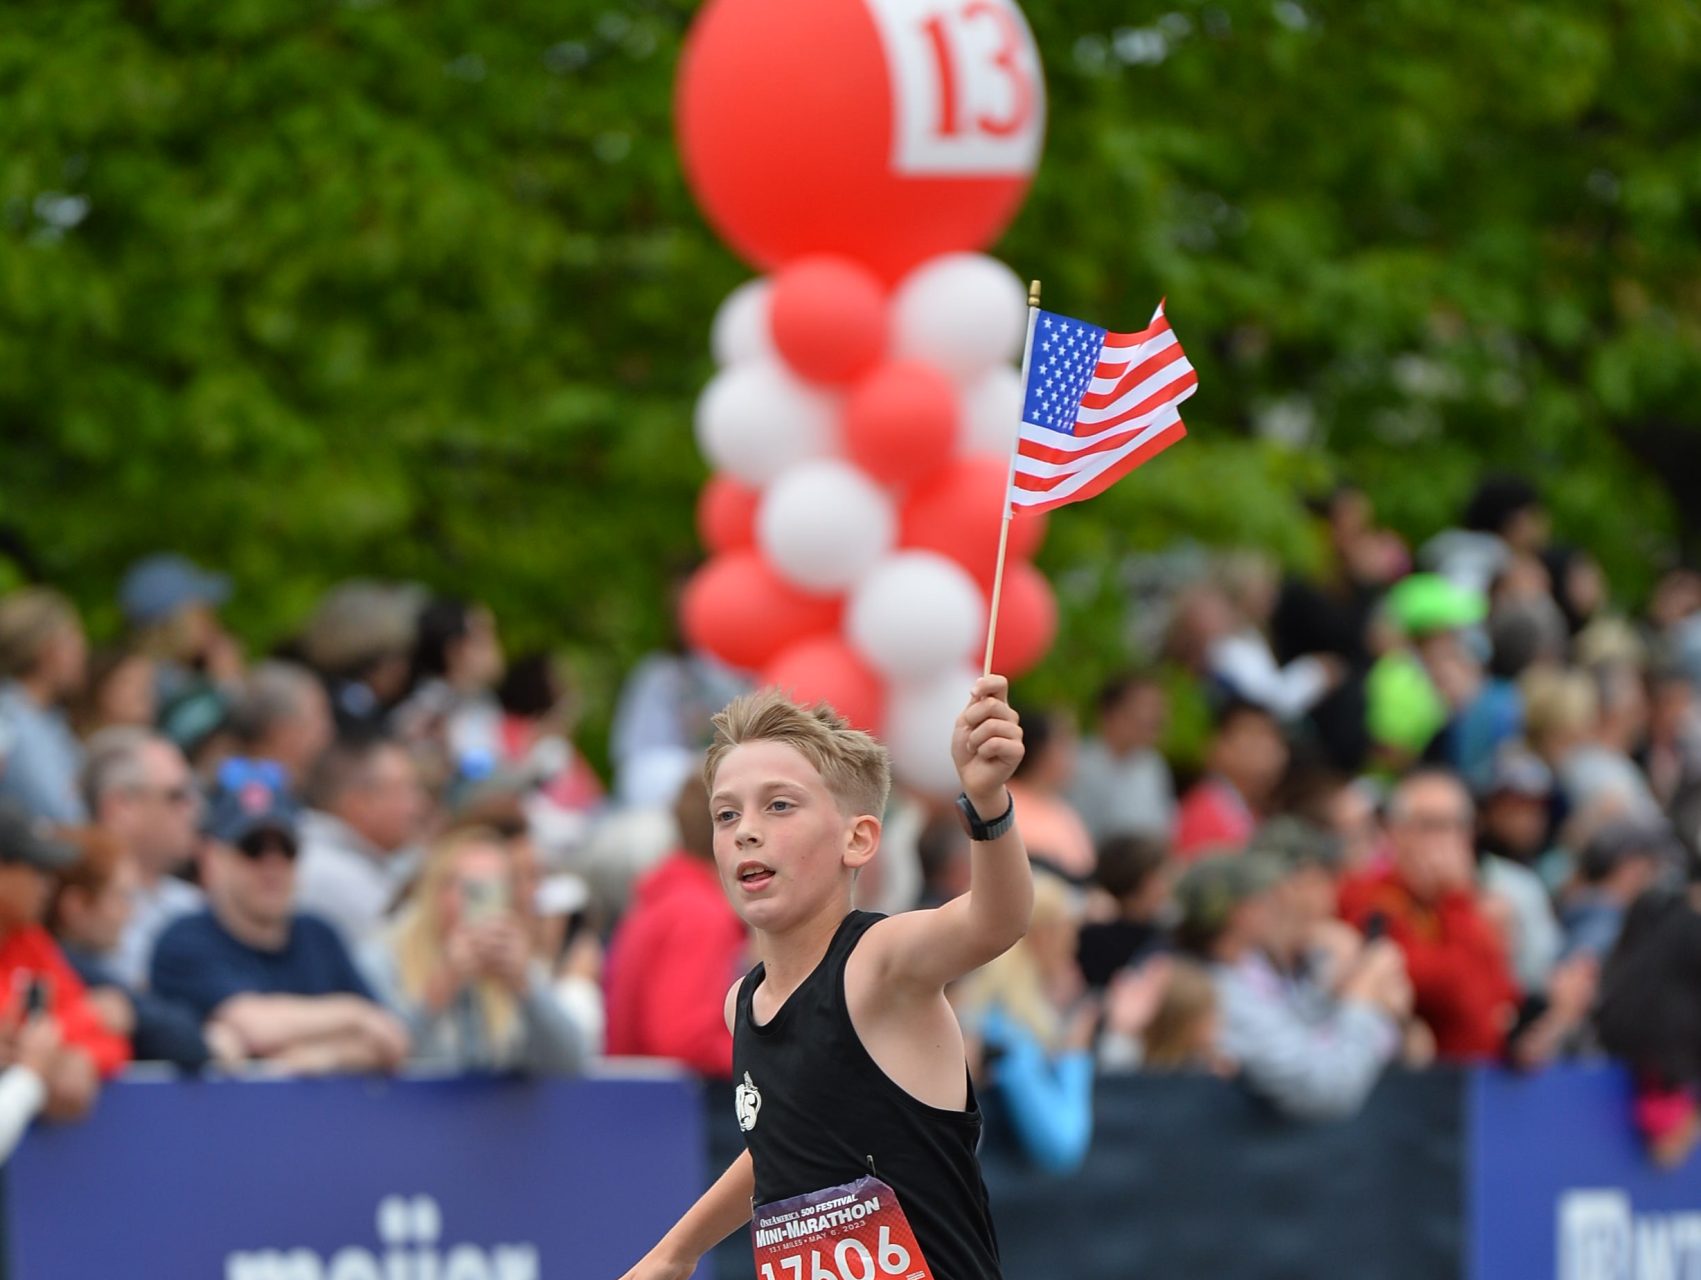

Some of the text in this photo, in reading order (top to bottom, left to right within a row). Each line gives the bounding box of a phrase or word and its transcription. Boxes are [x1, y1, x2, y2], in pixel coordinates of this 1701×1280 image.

[922, 1, 1034, 137] 13
[756, 1197, 880, 1248] MINI-MARATHON
[800, 1206, 815, 1217] 500
[815, 1194, 859, 1213] FESTIVAL
[782, 1239, 803, 1250] MILES
[808, 1230, 827, 1243] MAY
[843, 1220, 867, 1232] 2023
